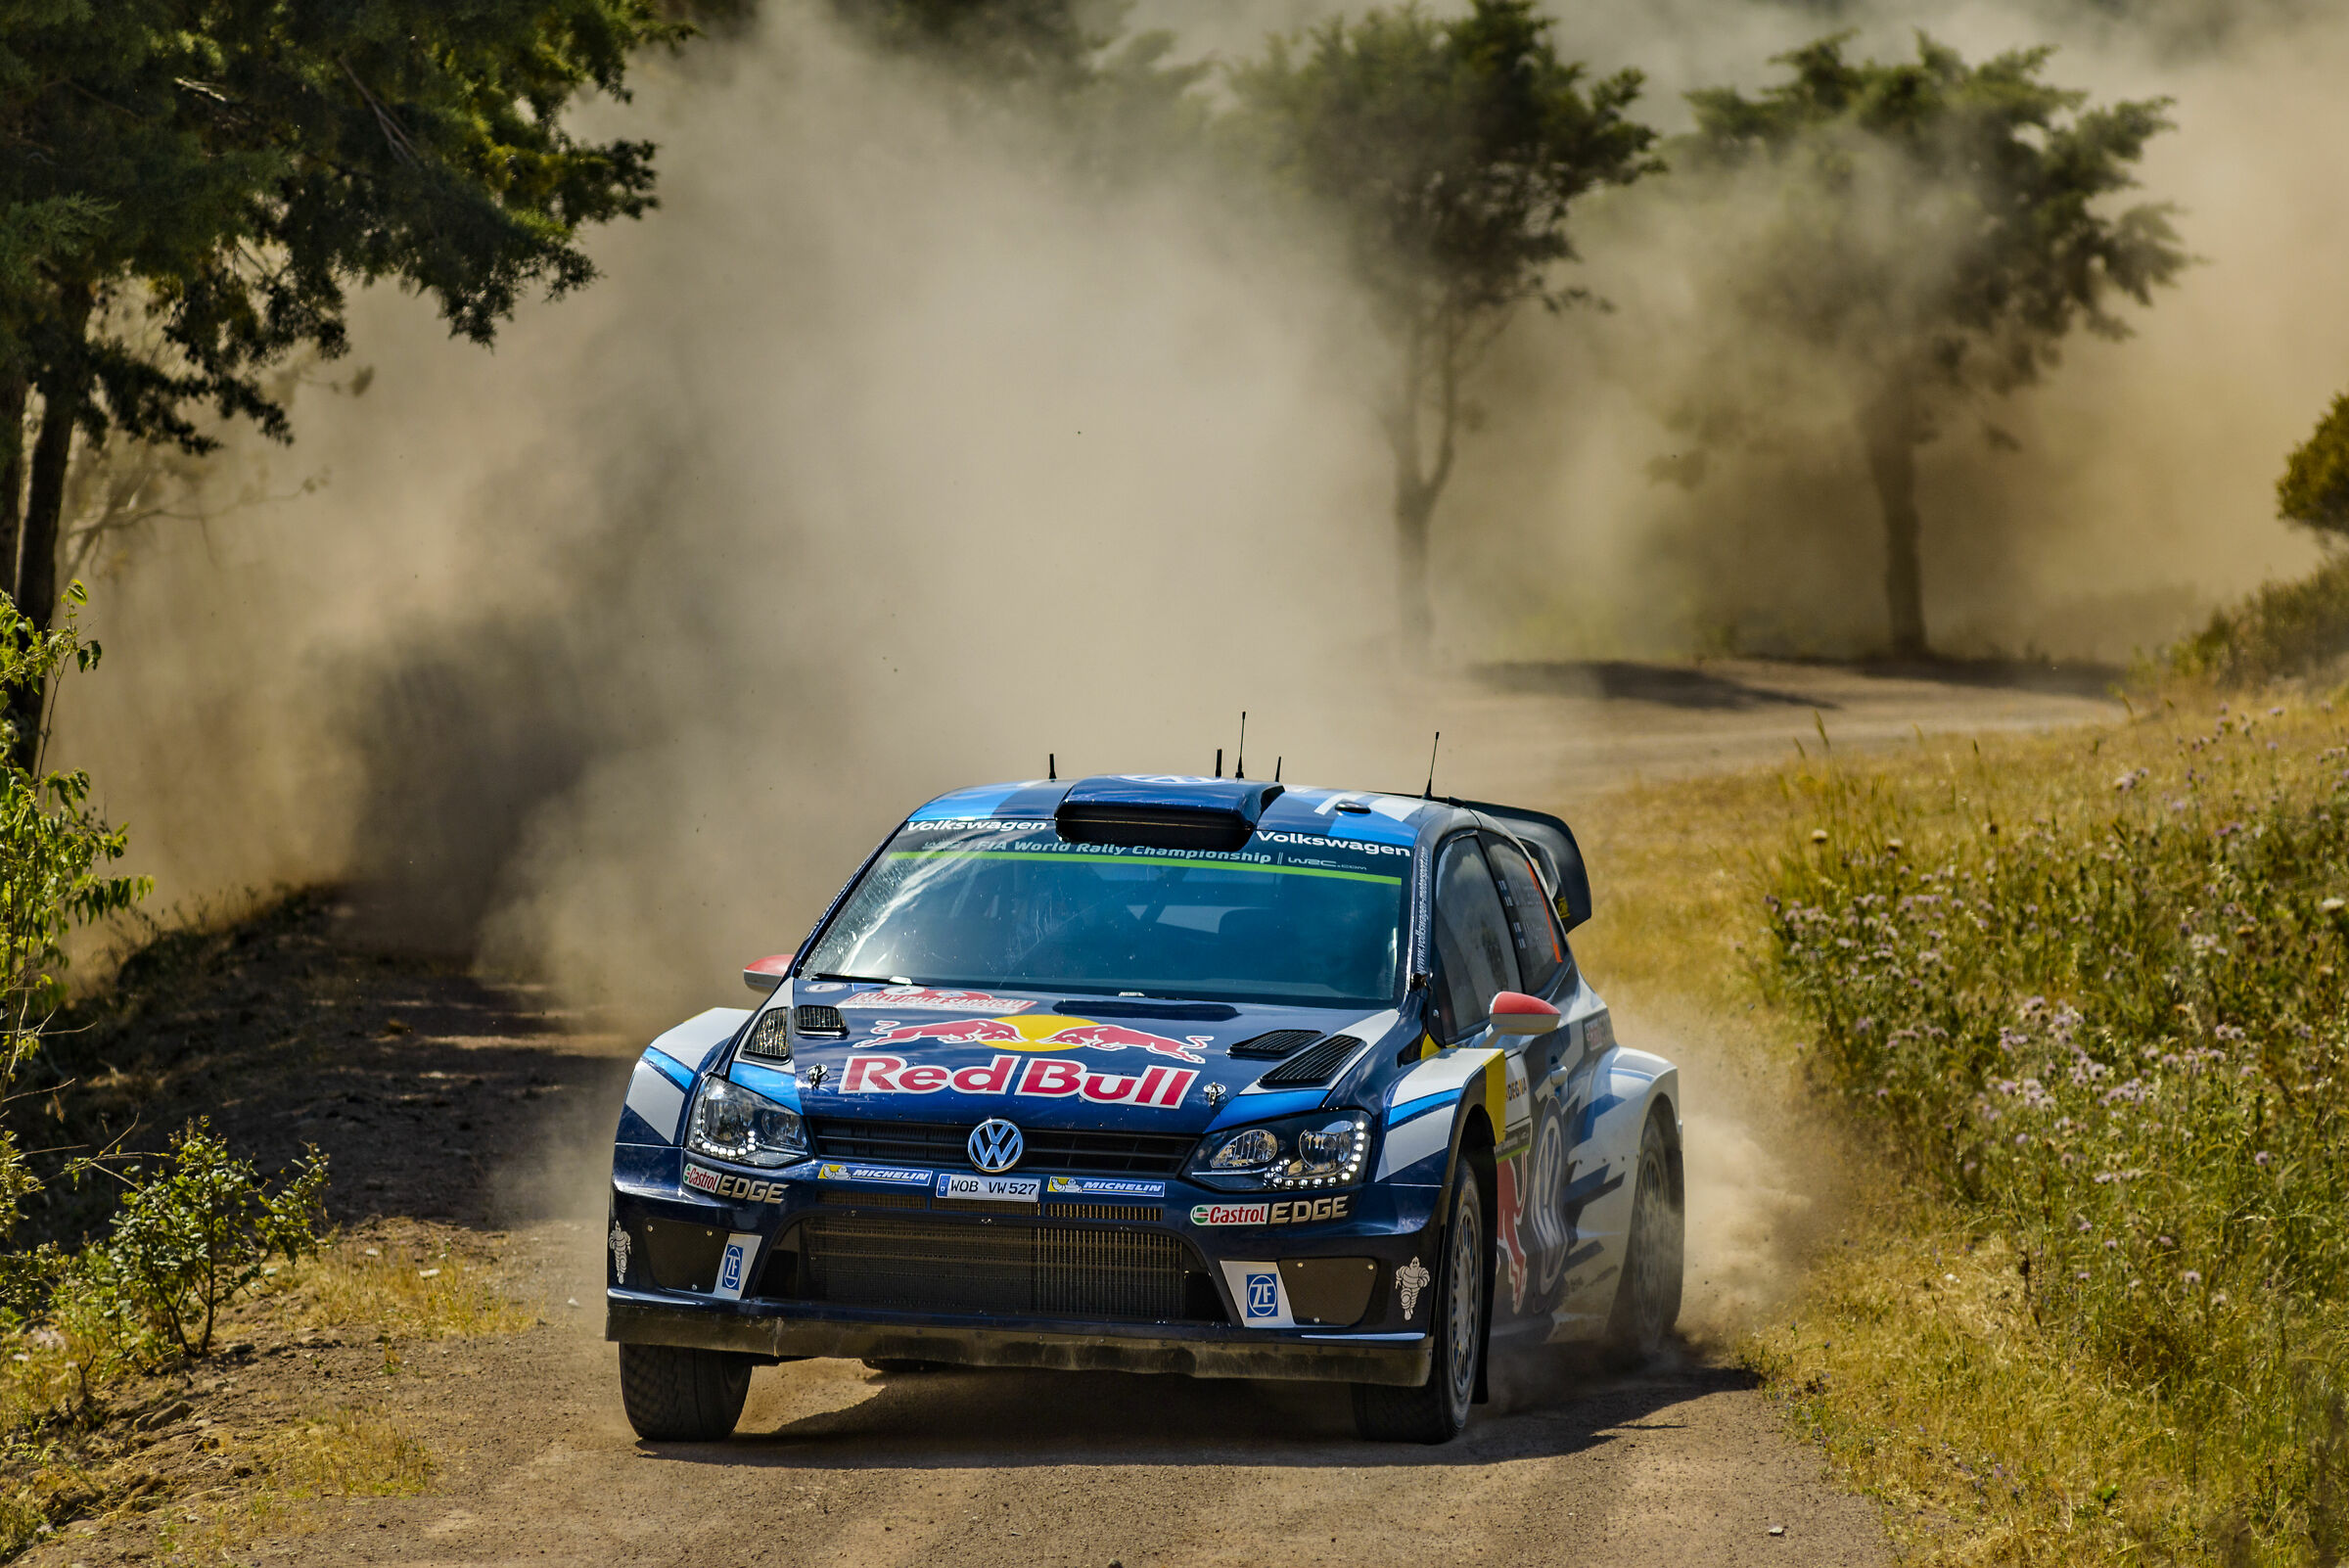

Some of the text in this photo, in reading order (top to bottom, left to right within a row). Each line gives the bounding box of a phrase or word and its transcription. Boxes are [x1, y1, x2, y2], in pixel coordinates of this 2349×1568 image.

[907, 820, 1047, 832] Volkswagen
[979, 841, 1006, 851] FIA
[1014, 841, 1071, 853] World
[1076, 843, 1127, 855] Rally
[1131, 846, 1271, 864] Championship
[1256, 830, 1410, 857] Volkswagen
[839, 1055, 1200, 1109] Red Bull
[968, 1118, 1024, 1173] VW
[688, 1167, 790, 1204] Castrol EDGE
[852, 1169, 929, 1181] MICHELIN
[950, 1179, 978, 1192] WOB
[989, 1181, 1008, 1194] VW
[1008, 1182, 1037, 1196] 527
[1082, 1181, 1163, 1192] MICHELIN
[1210, 1195, 1350, 1224] Castrol EDGE
